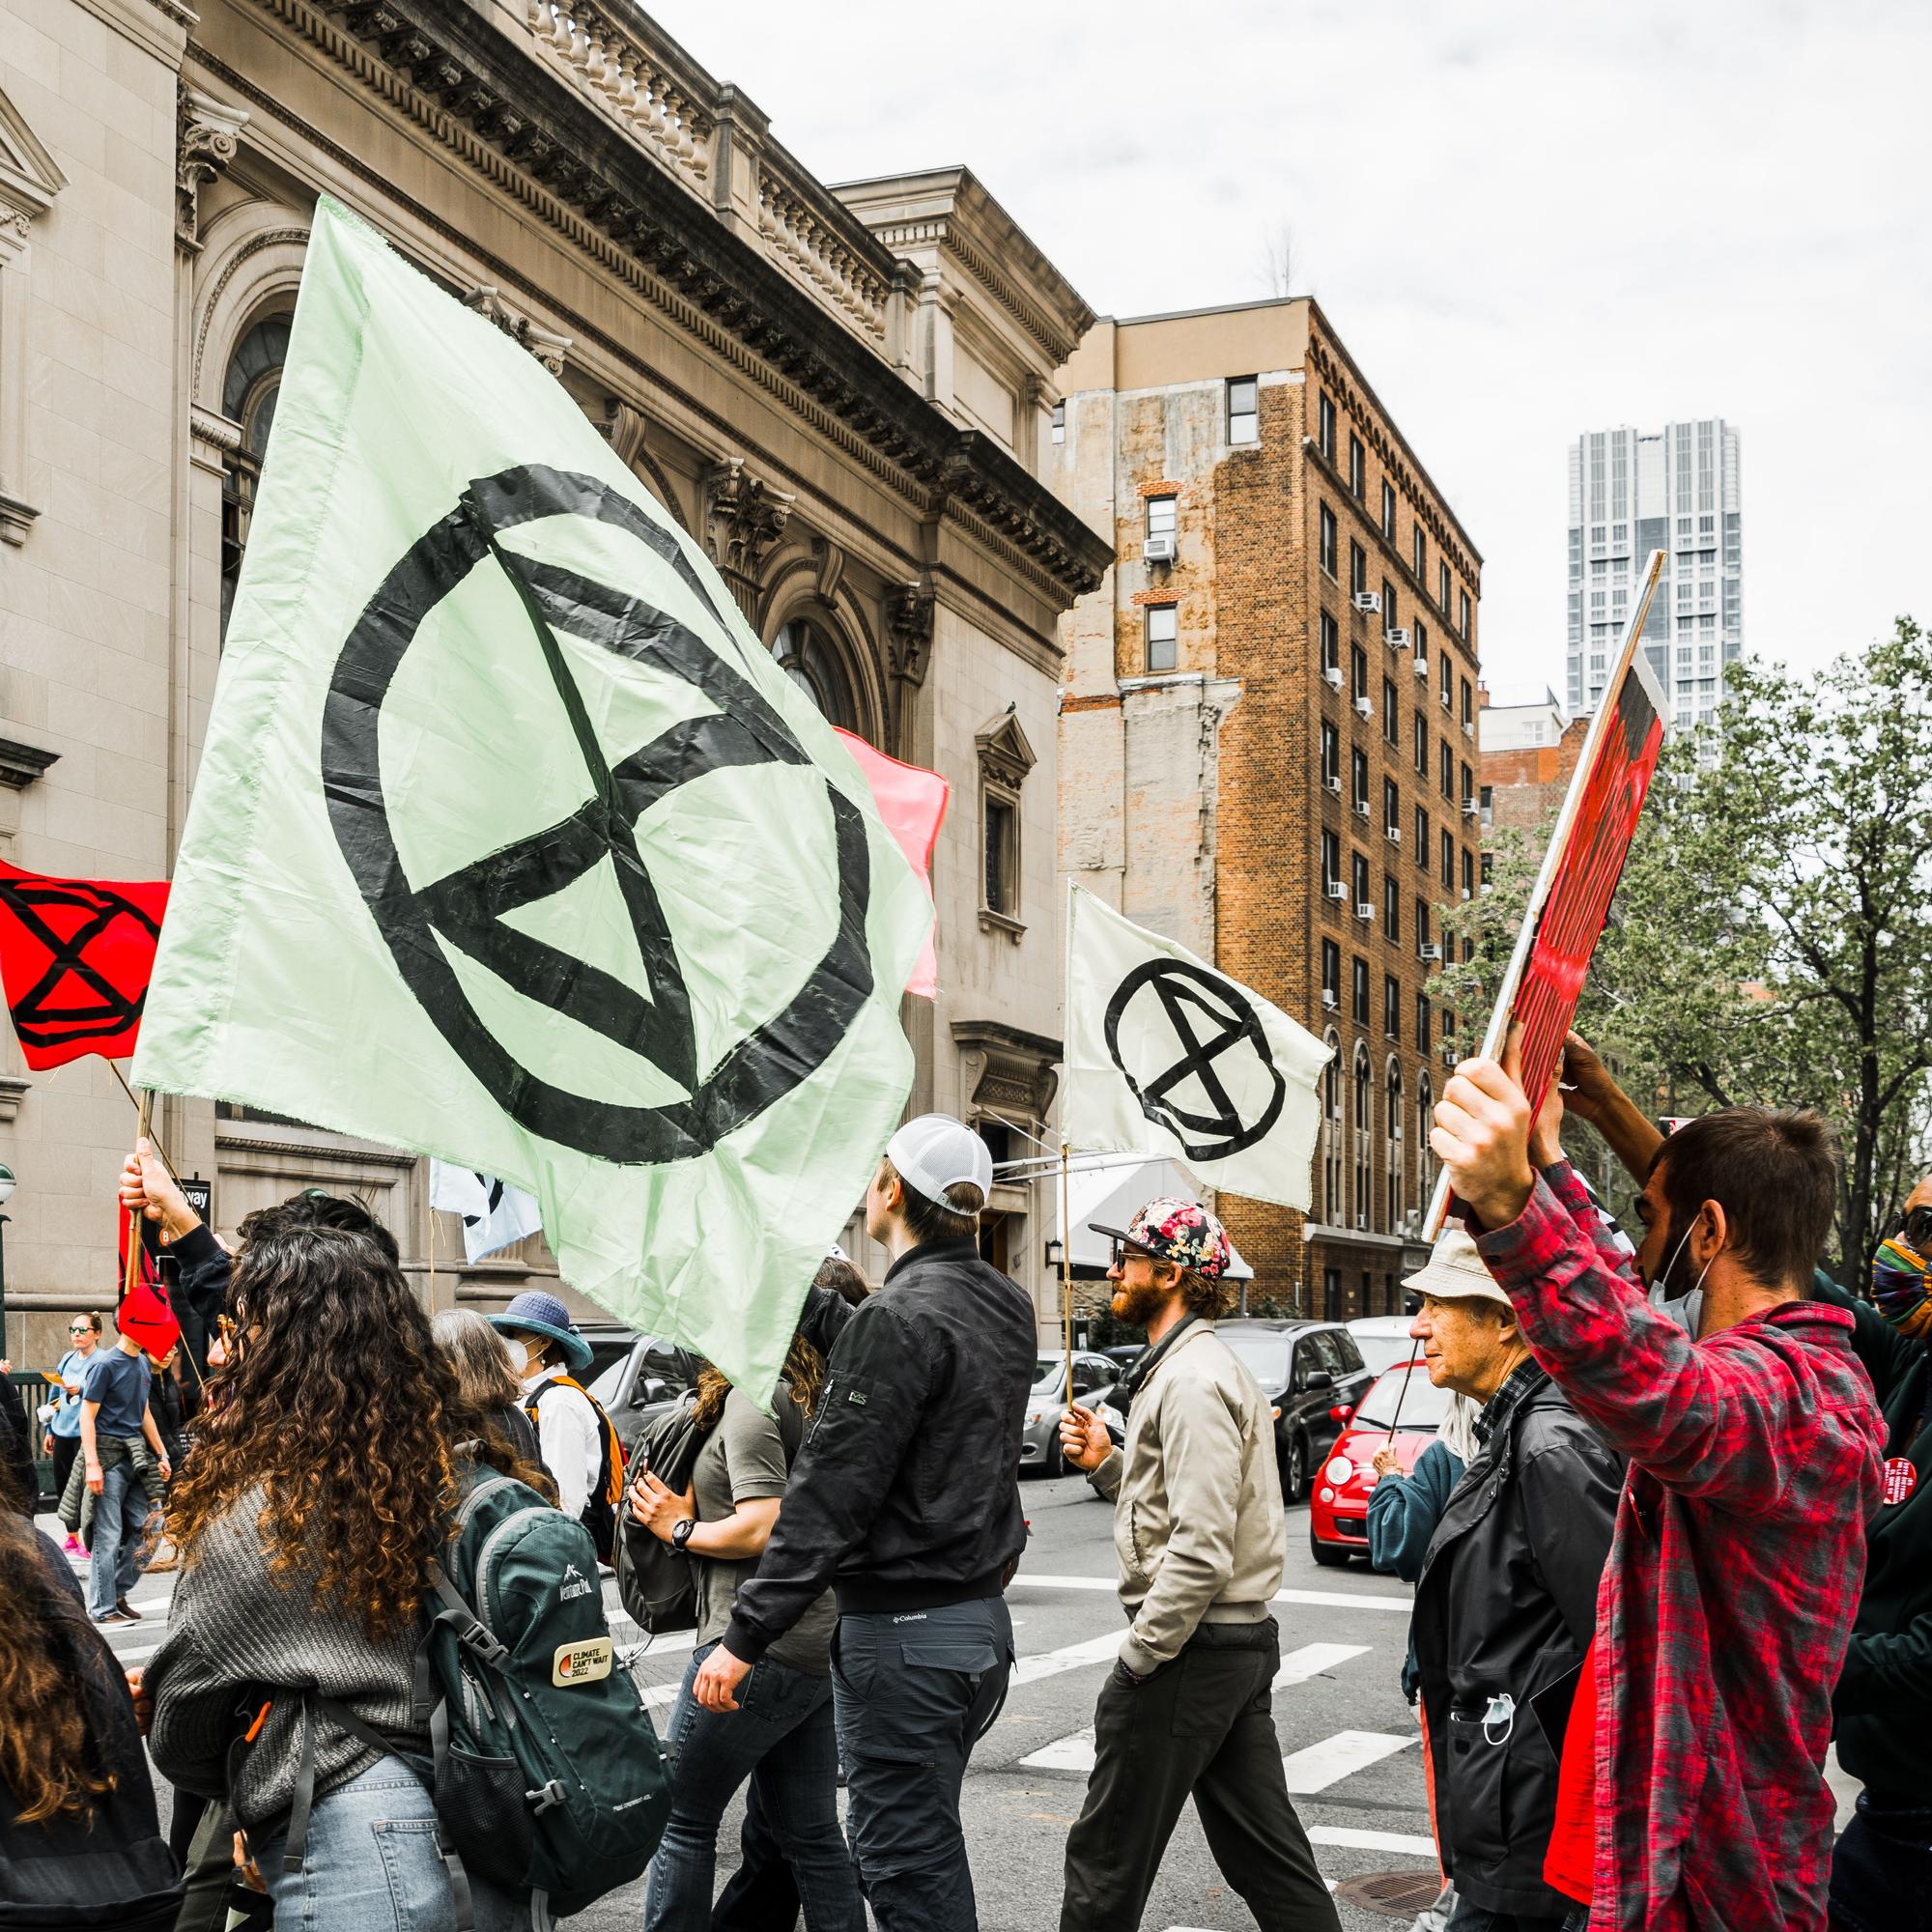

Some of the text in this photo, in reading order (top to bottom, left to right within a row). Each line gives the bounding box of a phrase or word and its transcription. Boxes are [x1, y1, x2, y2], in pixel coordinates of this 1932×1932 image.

[899, 1613, 927, 1622] Columbia
[573, 1648, 600, 1661] CLIMATE
[572, 1655, 609, 1668] CAN'T WAIT
[571, 1667, 588, 1677] 2022
